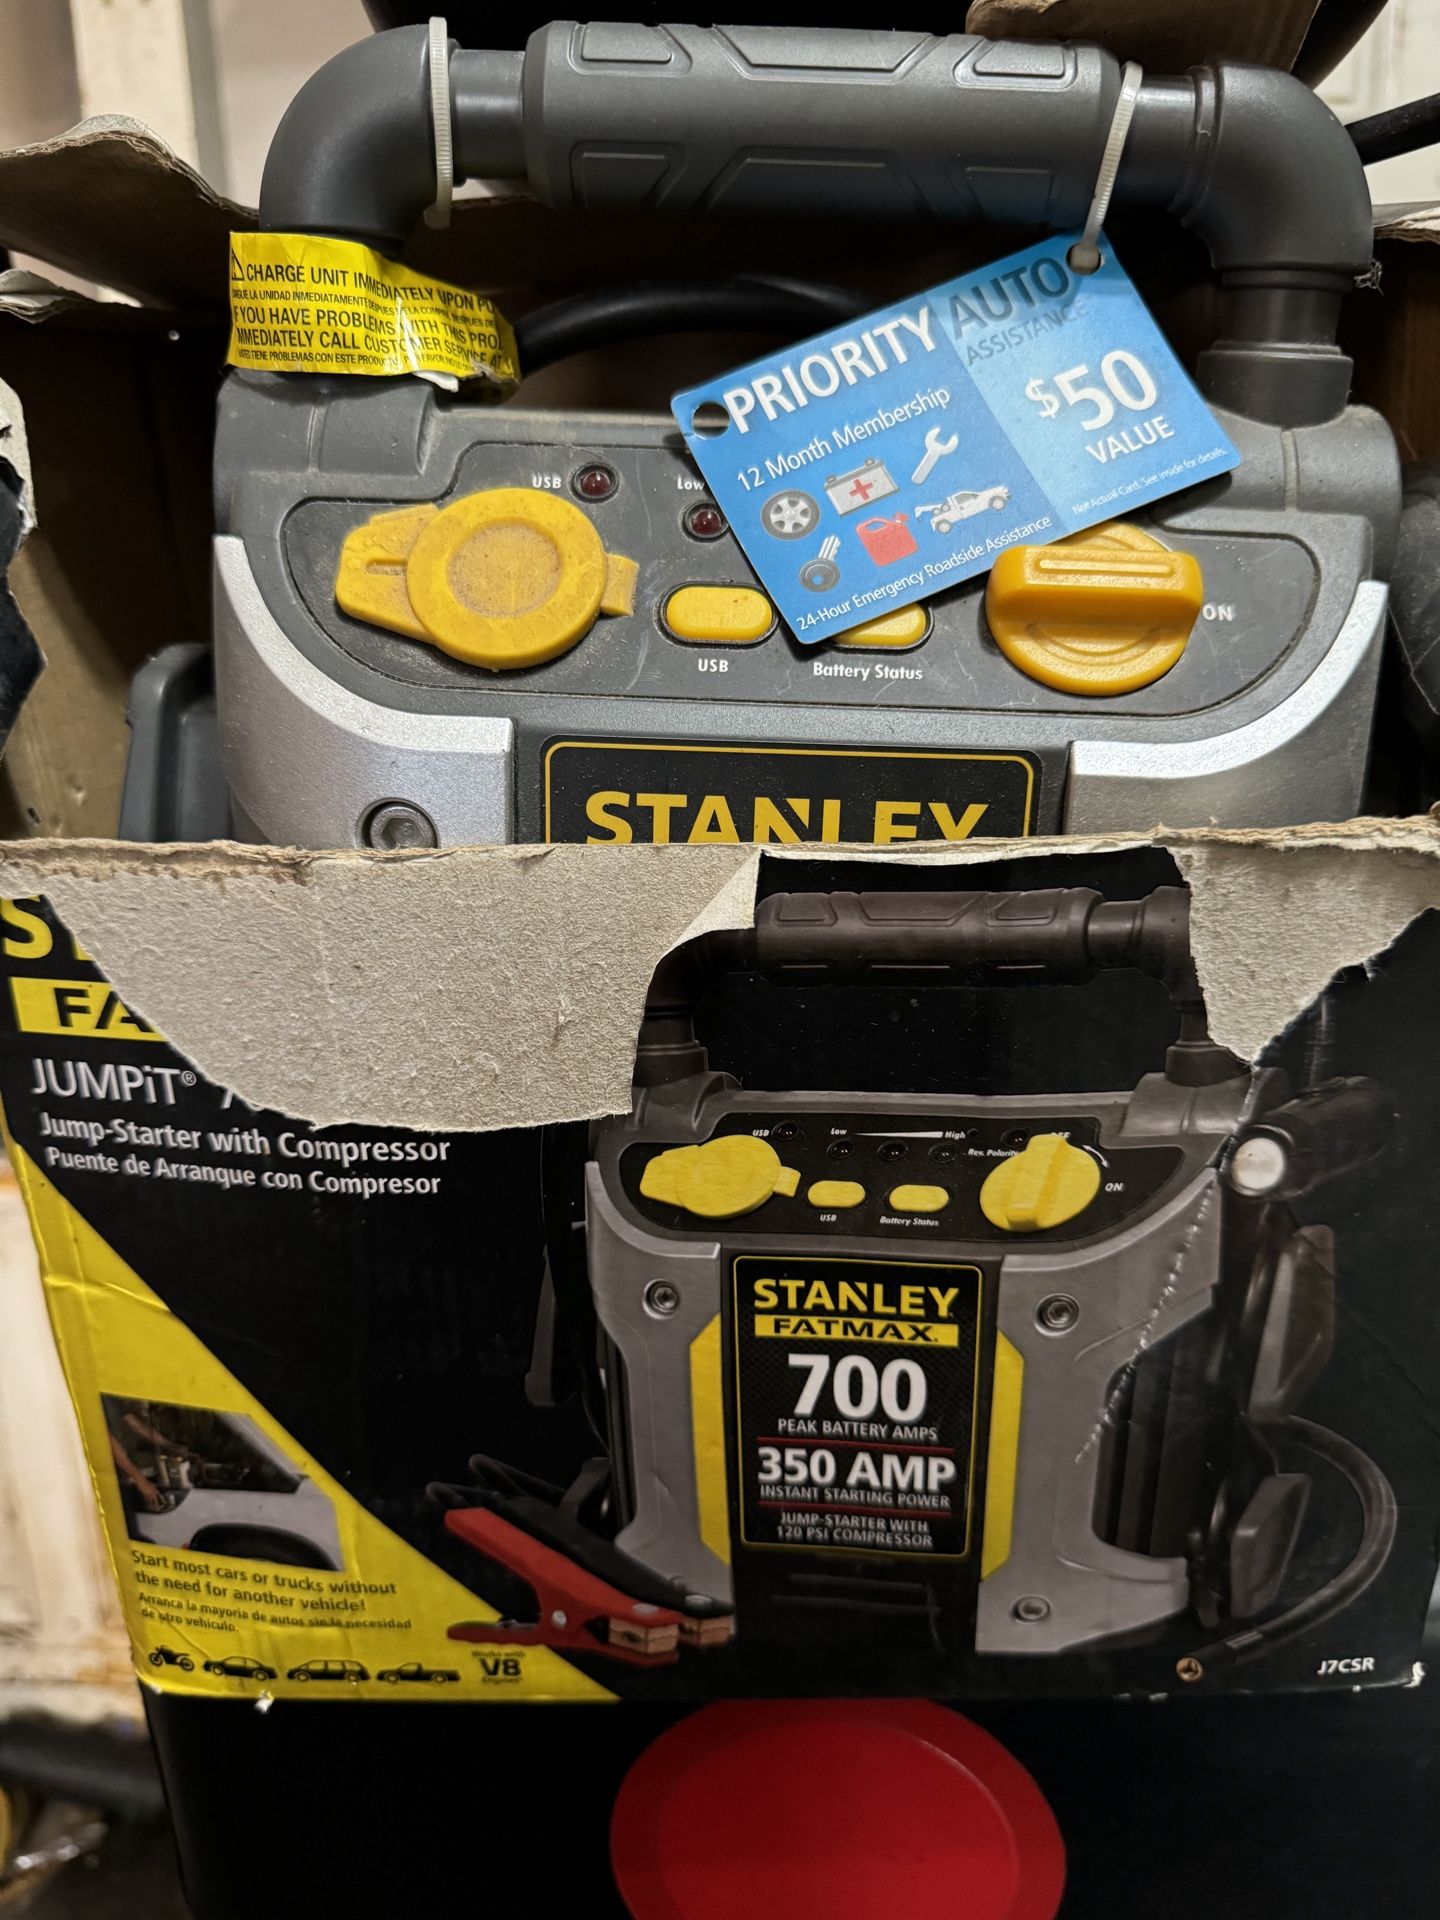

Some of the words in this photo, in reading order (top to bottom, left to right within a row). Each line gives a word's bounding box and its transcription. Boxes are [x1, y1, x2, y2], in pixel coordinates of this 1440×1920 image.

[247, 263, 305, 283] CHARGE
[310, 266, 349, 287] UNIT
[353, 271, 433, 301] IMMEDIATELY
[437, 288, 475, 311] UPON
[259, 290, 291, 301] UNIDAD
[948, 257, 1070, 340] AUTO
[240, 306, 266, 324] YOU
[270, 307, 312, 326] HAVE
[316, 309, 396, 336] PROBLEMS
[400, 319, 440, 334] WITH
[441, 322, 467, 344] THIS
[965, 298, 1088, 366] ASSISTANCE
[319, 330, 361, 350] CALL
[364, 333, 442, 355] CUSTOMER
[269, 350, 314, 363] PROBLEMAS
[315, 352, 335, 363] CON
[335, 353, 357, 365] ESTE
[723, 306, 936, 435] PRIORITY
[1025, 350, 1157, 432] $50
[737, 466, 766, 492] 12
[764, 435, 833, 480] Month
[831, 387, 951, 450] Membership
[1085, 415, 1175, 465] VALUE
[532, 474, 562, 490] USB
[677, 473, 704, 491] Low
[1091, 488, 1118, 507] Actual
[1143, 474, 1160, 487] See
[1158, 463, 1185, 481] inside
[1183, 457, 1198, 471] for
[796, 600, 852, 631] 24-Hour
[851, 570, 924, 609] Emergency
[923, 543, 985, 578] Roadside
[986, 515, 1052, 553] Assistance
[1202, 604, 1233, 622] ON
[698, 658, 729, 673] USB
[813, 661, 870, 682] Battery
[875, 664, 923, 680] Status
[585, 790, 989, 845] STANLEY
[39, 1111, 203, 1150] Jump-Starter
[208, 1127, 270, 1155] with
[277, 1131, 451, 1169] Compressor
[752, 1128, 770, 1138] USB
[830, 1127, 848, 1136] Low
[944, 1130, 966, 1141] High
[967, 1148, 985, 1157] Rev.
[45, 1146, 119, 1174] Puente
[122, 1153, 152, 1176] de
[154, 1157, 257, 1191] Arranque
[261, 1171, 302, 1191] con
[307, 1169, 441, 1200] Compresor
[1104, 1182, 1124, 1193] ON
[819, 1213, 837, 1222] USB
[879, 1215, 911, 1226] Battery
[912, 1217, 940, 1227] Status
[753, 1278, 959, 1318] STANLEY
[773, 1317, 935, 1343] FATMAX
[787, 1352, 928, 1424] 700
[777, 1418, 818, 1434] PEAK
[822, 1420, 888, 1438] BATTERY
[891, 1424, 938, 1441] AMPS
[757, 1446, 837, 1485] 350
[845, 1451, 957, 1492] AMP
[760, 1484, 819, 1500] INSTANT
[824, 1487, 893, 1505] STARTING
[897, 1492, 950, 1508] POWER
[780, 1511, 888, 1529] JUMP-STARTER
[889, 1518, 930, 1534] WITH
[775, 1524, 803, 1539] 120
[806, 1525, 830, 1541] PSI
[832, 1527, 934, 1547] COMPRESSOR
[131, 1549, 170, 1569] Start
[172, 1558, 212, 1577] most
[215, 1566, 249, 1582] cars
[252, 1571, 269, 1585] or
[273, 1573, 325, 1593] trucks
[328, 1579, 398, 1595] without
[135, 1569, 160, 1587] the
[163, 1577, 202, 1594] need
[205, 1581, 229, 1598] for
[233, 1588, 295, 1608] another
[300, 1597, 366, 1612] vehicle!
[138, 1591, 184, 1610] Arranca
[186, 1598, 198, 1612] la
[251, 1609, 268, 1622] de
[269, 1613, 306, 1627] autos
[345, 1617, 413, 1630] necesidad
[141, 1605, 156, 1618] de
[158, 1610, 184, 1625] otro
[480, 1657, 522, 1676] V8
[1316, 1656, 1375, 1675] J7CSR
